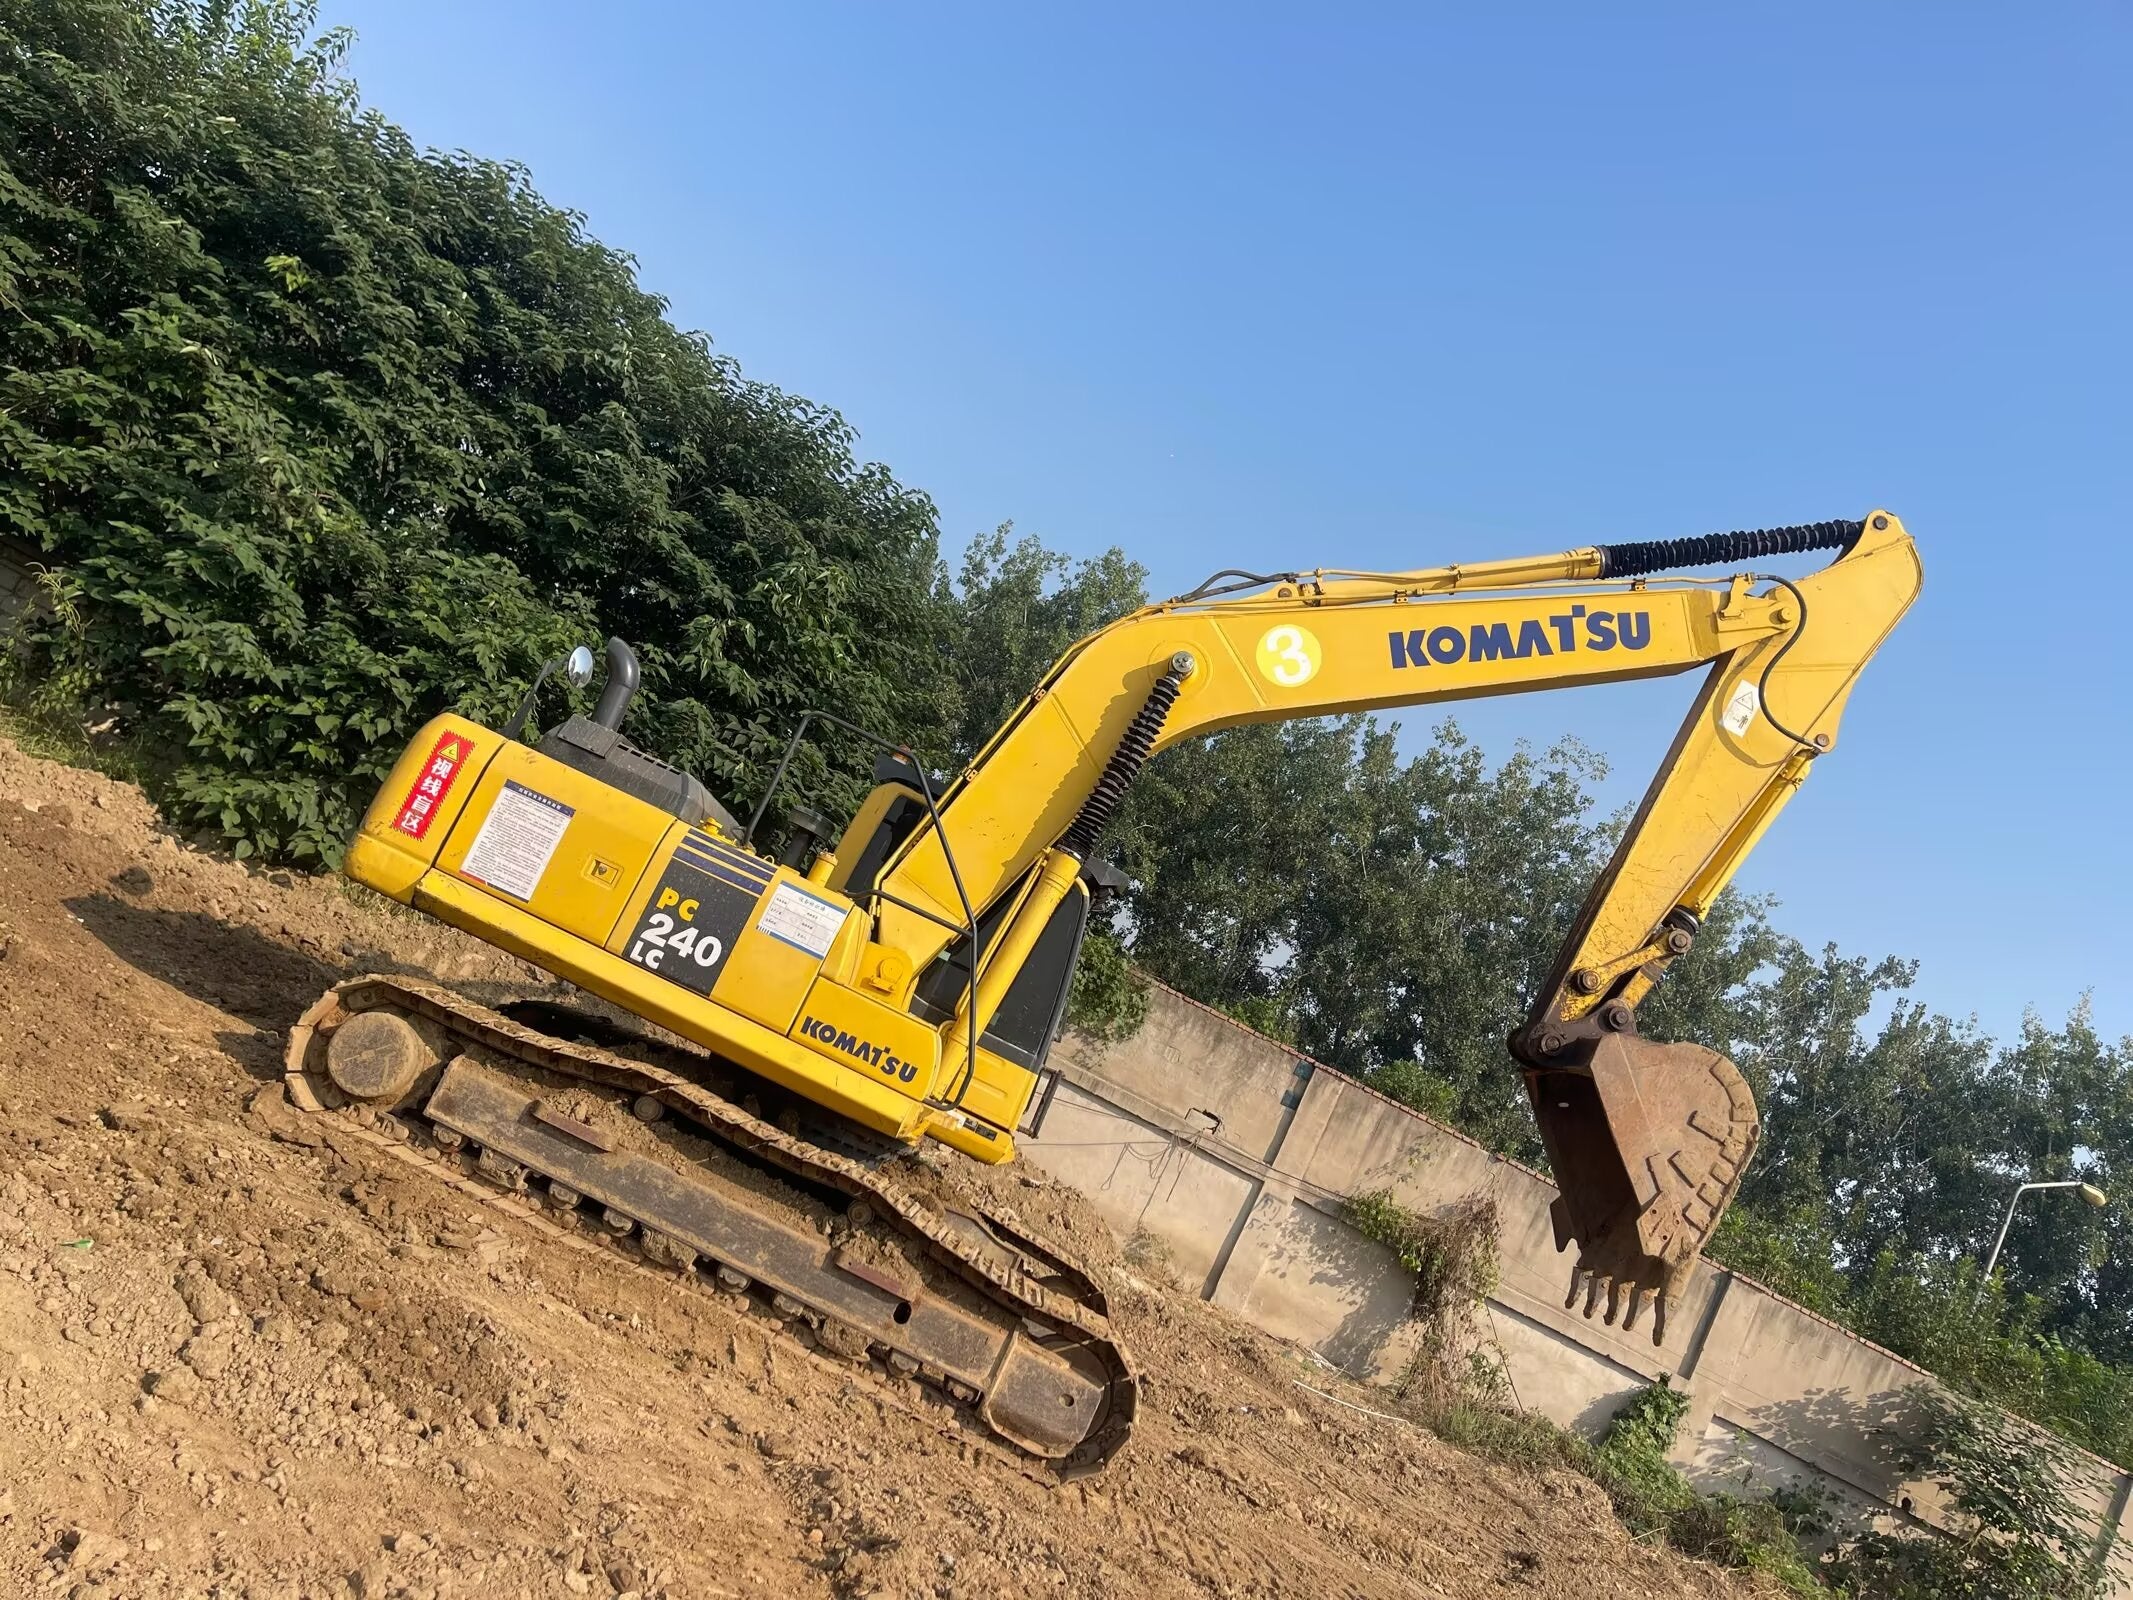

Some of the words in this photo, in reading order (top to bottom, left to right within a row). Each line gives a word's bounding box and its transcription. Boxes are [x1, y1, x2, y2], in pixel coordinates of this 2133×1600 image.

[1266, 627, 1312, 685] 3
[1388, 604, 1651, 669] KOMATSU
[400, 757, 454, 833] 视线盲区
[656, 886, 700, 922] PC
[629, 940, 665, 970] LC
[640, 912, 722, 967] 240
[800, 1016, 919, 1083] KOMATSU
